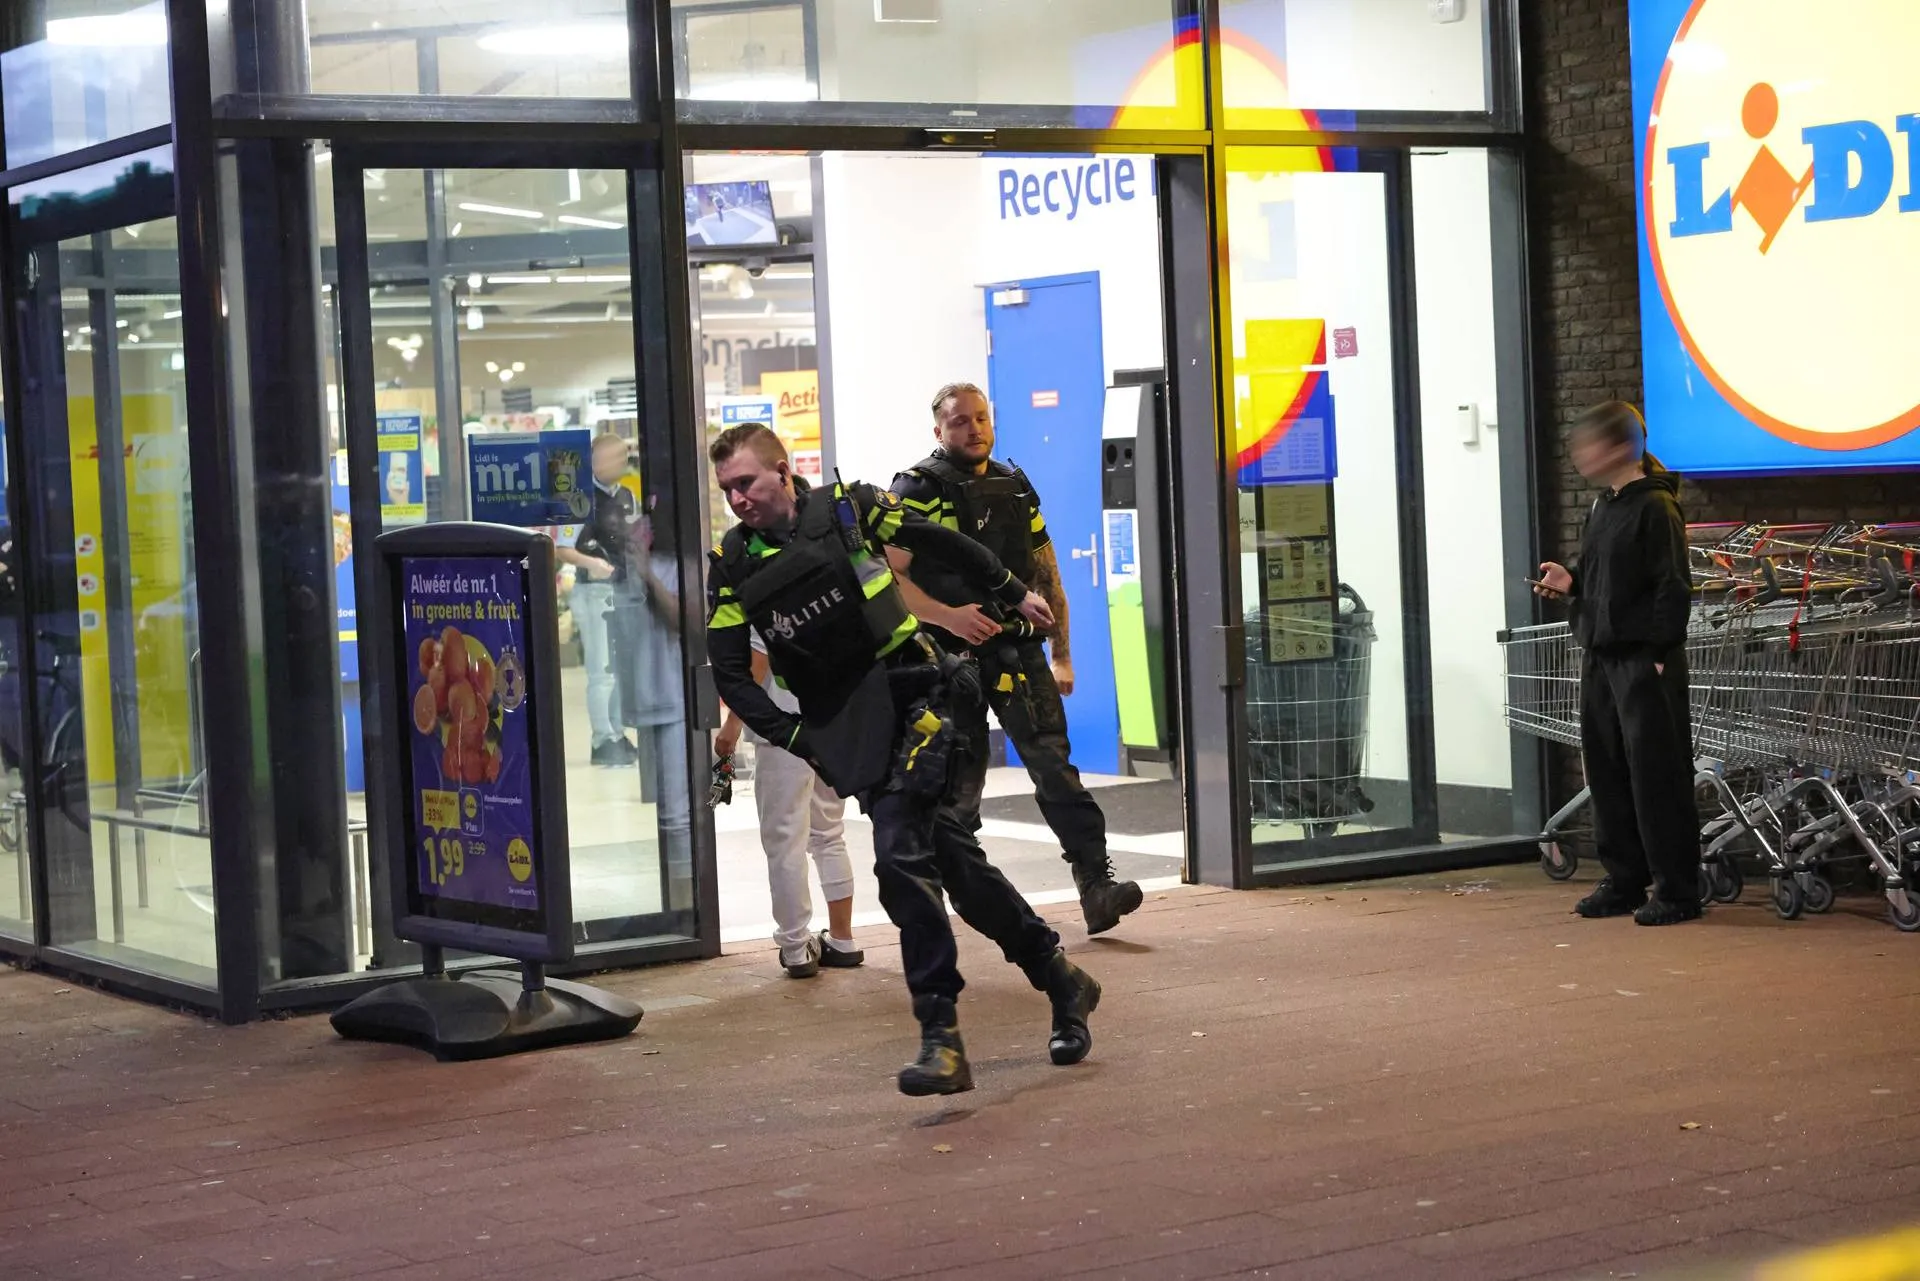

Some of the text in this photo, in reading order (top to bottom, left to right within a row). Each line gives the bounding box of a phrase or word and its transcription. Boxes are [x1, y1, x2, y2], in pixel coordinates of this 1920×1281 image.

[999, 158, 1135, 220] Recycle
[779, 387, 820, 408] Acti
[411, 574, 496, 593] Alwéér de nr. 1
[412, 599, 520, 624] in groente & fruit.
[423, 836, 464, 887] 1.99
